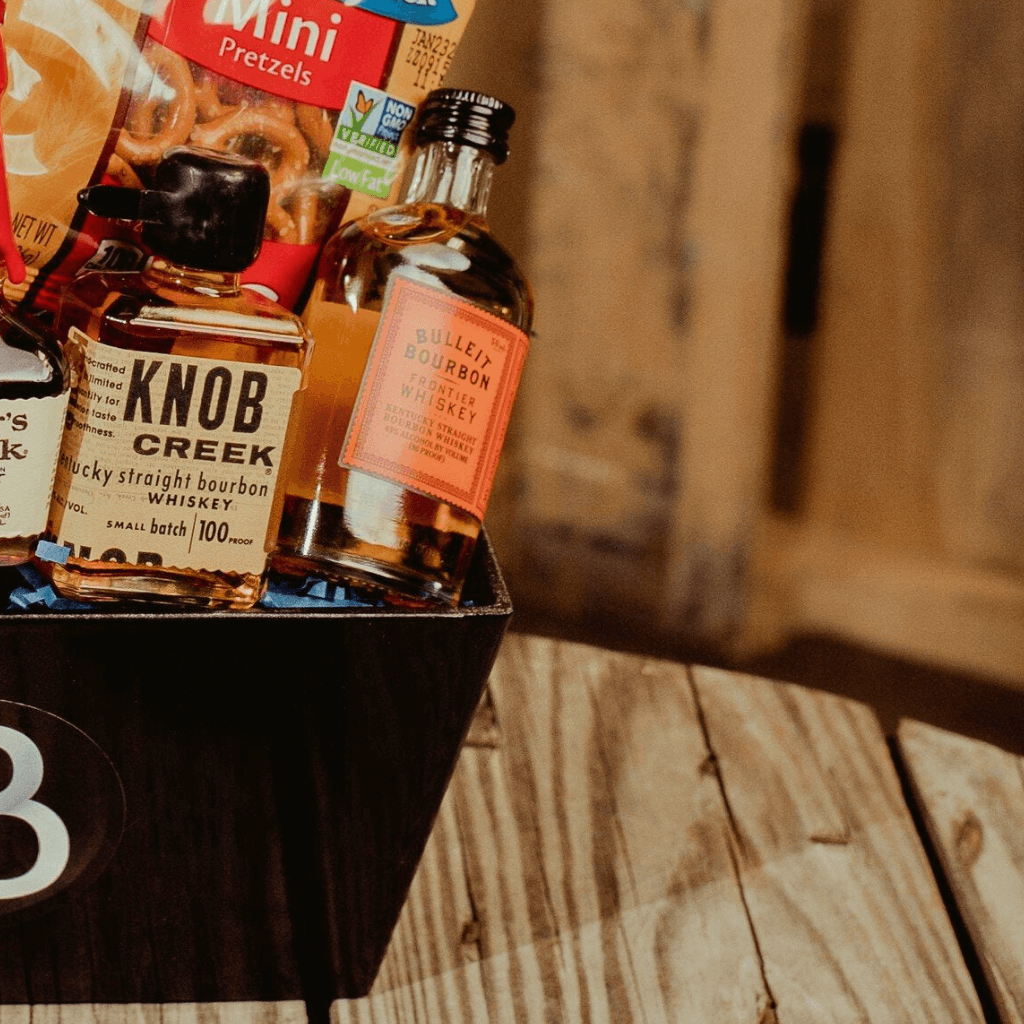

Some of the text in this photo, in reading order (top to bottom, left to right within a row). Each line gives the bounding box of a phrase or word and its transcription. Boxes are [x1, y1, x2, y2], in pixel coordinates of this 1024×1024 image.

[219, 36, 313, 86] Pretzels
[382, 114, 407, 131] GMO
[386, 99, 413, 120] NON
[341, 127, 397, 157] VERIFIED
[11, 213, 55, 245] NET WT
[415, 325, 493, 364] BULLEIT
[89, 374, 123, 390] limited
[403, 344, 491, 388] BOURBON
[105, 396, 121, 406] for
[123, 358, 268, 434] KNOB
[399, 385, 476, 422] WHISKEY
[409, 374, 475, 405] FRONTIER
[92, 409, 117, 422] taste
[384, 404, 476, 444] KENTUCKY STRAIGHT
[383, 413, 474, 453] BOURBON WHISKEY
[132, 433, 277, 467] CREEK
[60, 453, 268, 497] entucky straight bourbon
[147, 492, 233, 511] WHISKEY
[106, 518, 253, 545] SMALL batch 100 PROOF
